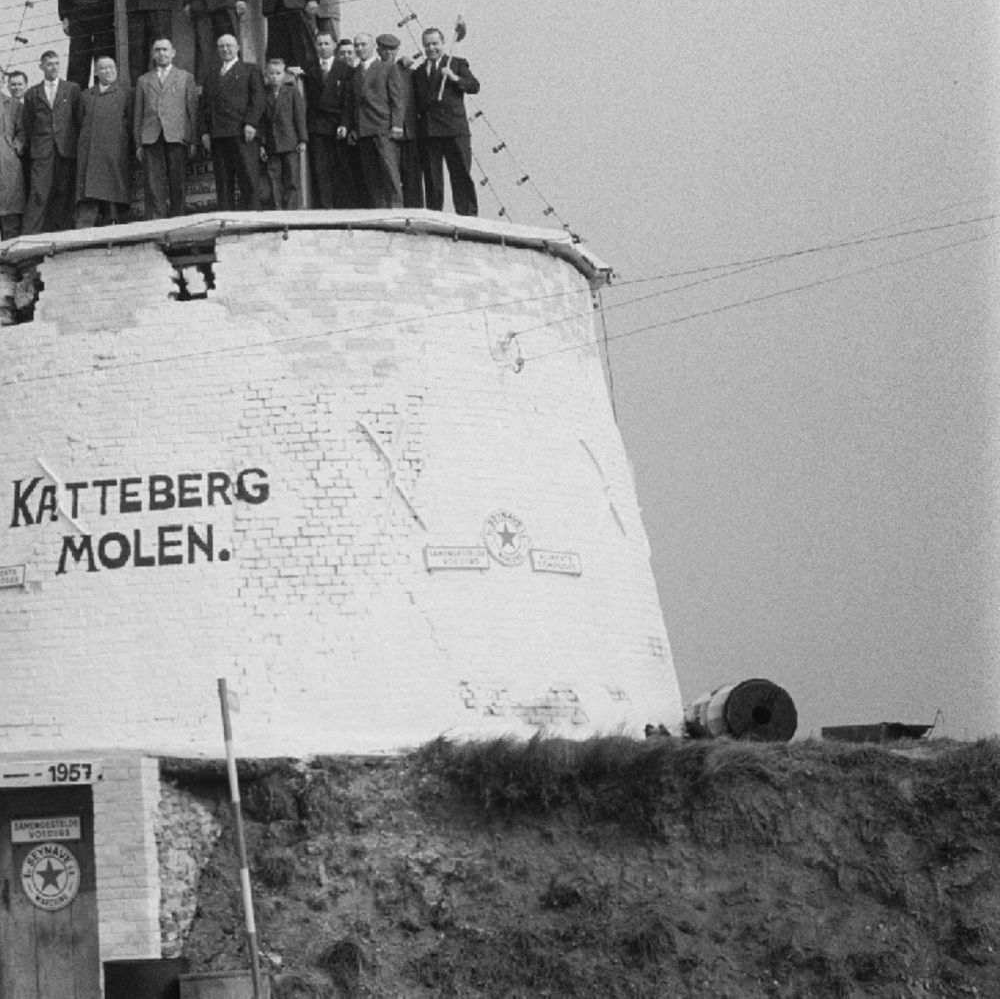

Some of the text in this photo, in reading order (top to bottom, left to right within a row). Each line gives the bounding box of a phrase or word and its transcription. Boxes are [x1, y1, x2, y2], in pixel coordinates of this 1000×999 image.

[9, 468, 269, 527] KATTEBERG
[55, 523, 231, 575] MOLEN.
[13, 818, 79, 832] SAMENGESTELDE
[28, 829, 71, 839] VOEDERS
